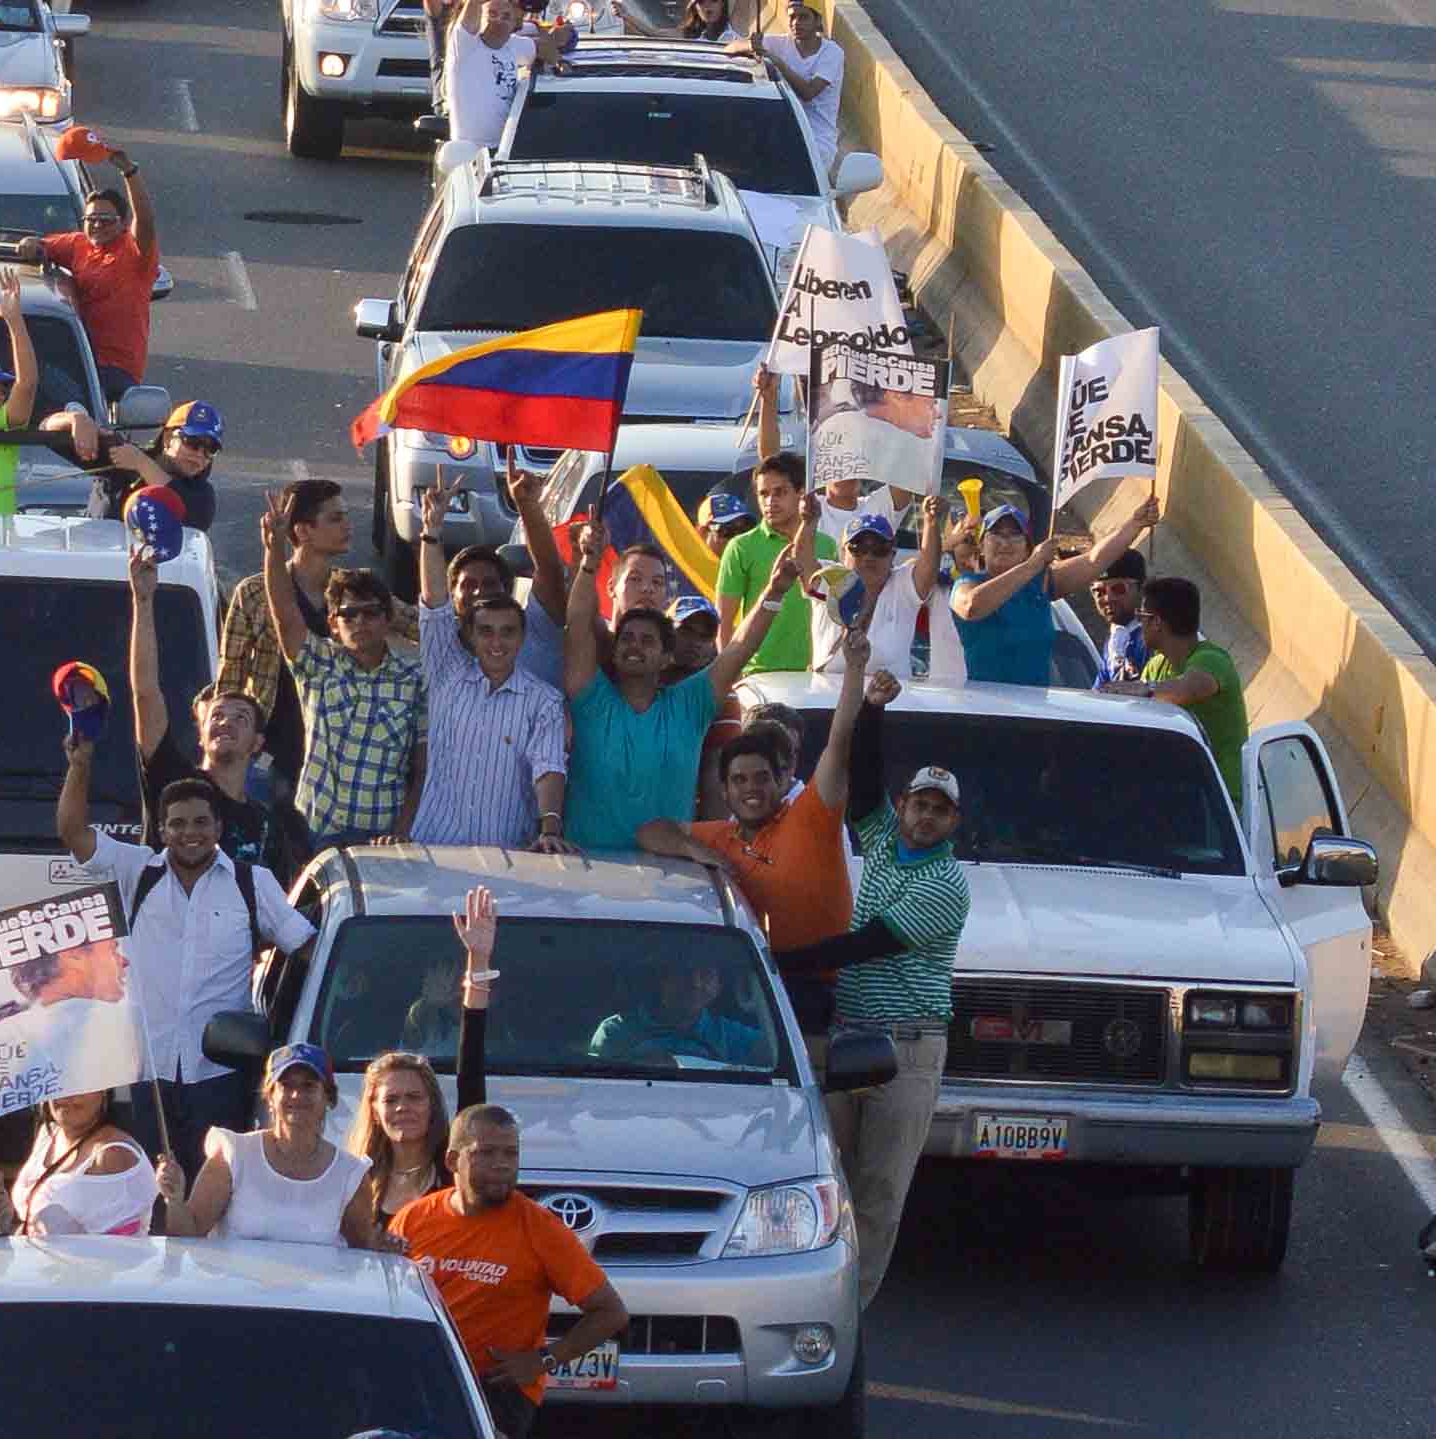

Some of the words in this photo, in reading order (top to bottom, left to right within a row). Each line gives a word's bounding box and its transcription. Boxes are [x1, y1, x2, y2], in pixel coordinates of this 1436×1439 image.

[1071, 376, 1109, 411] UE
[1065, 413, 1152, 460] ANSA,
[979, 1125, 1063, 1150] A10BB9V
[439, 1258, 509, 1278] VOLUNTAD
